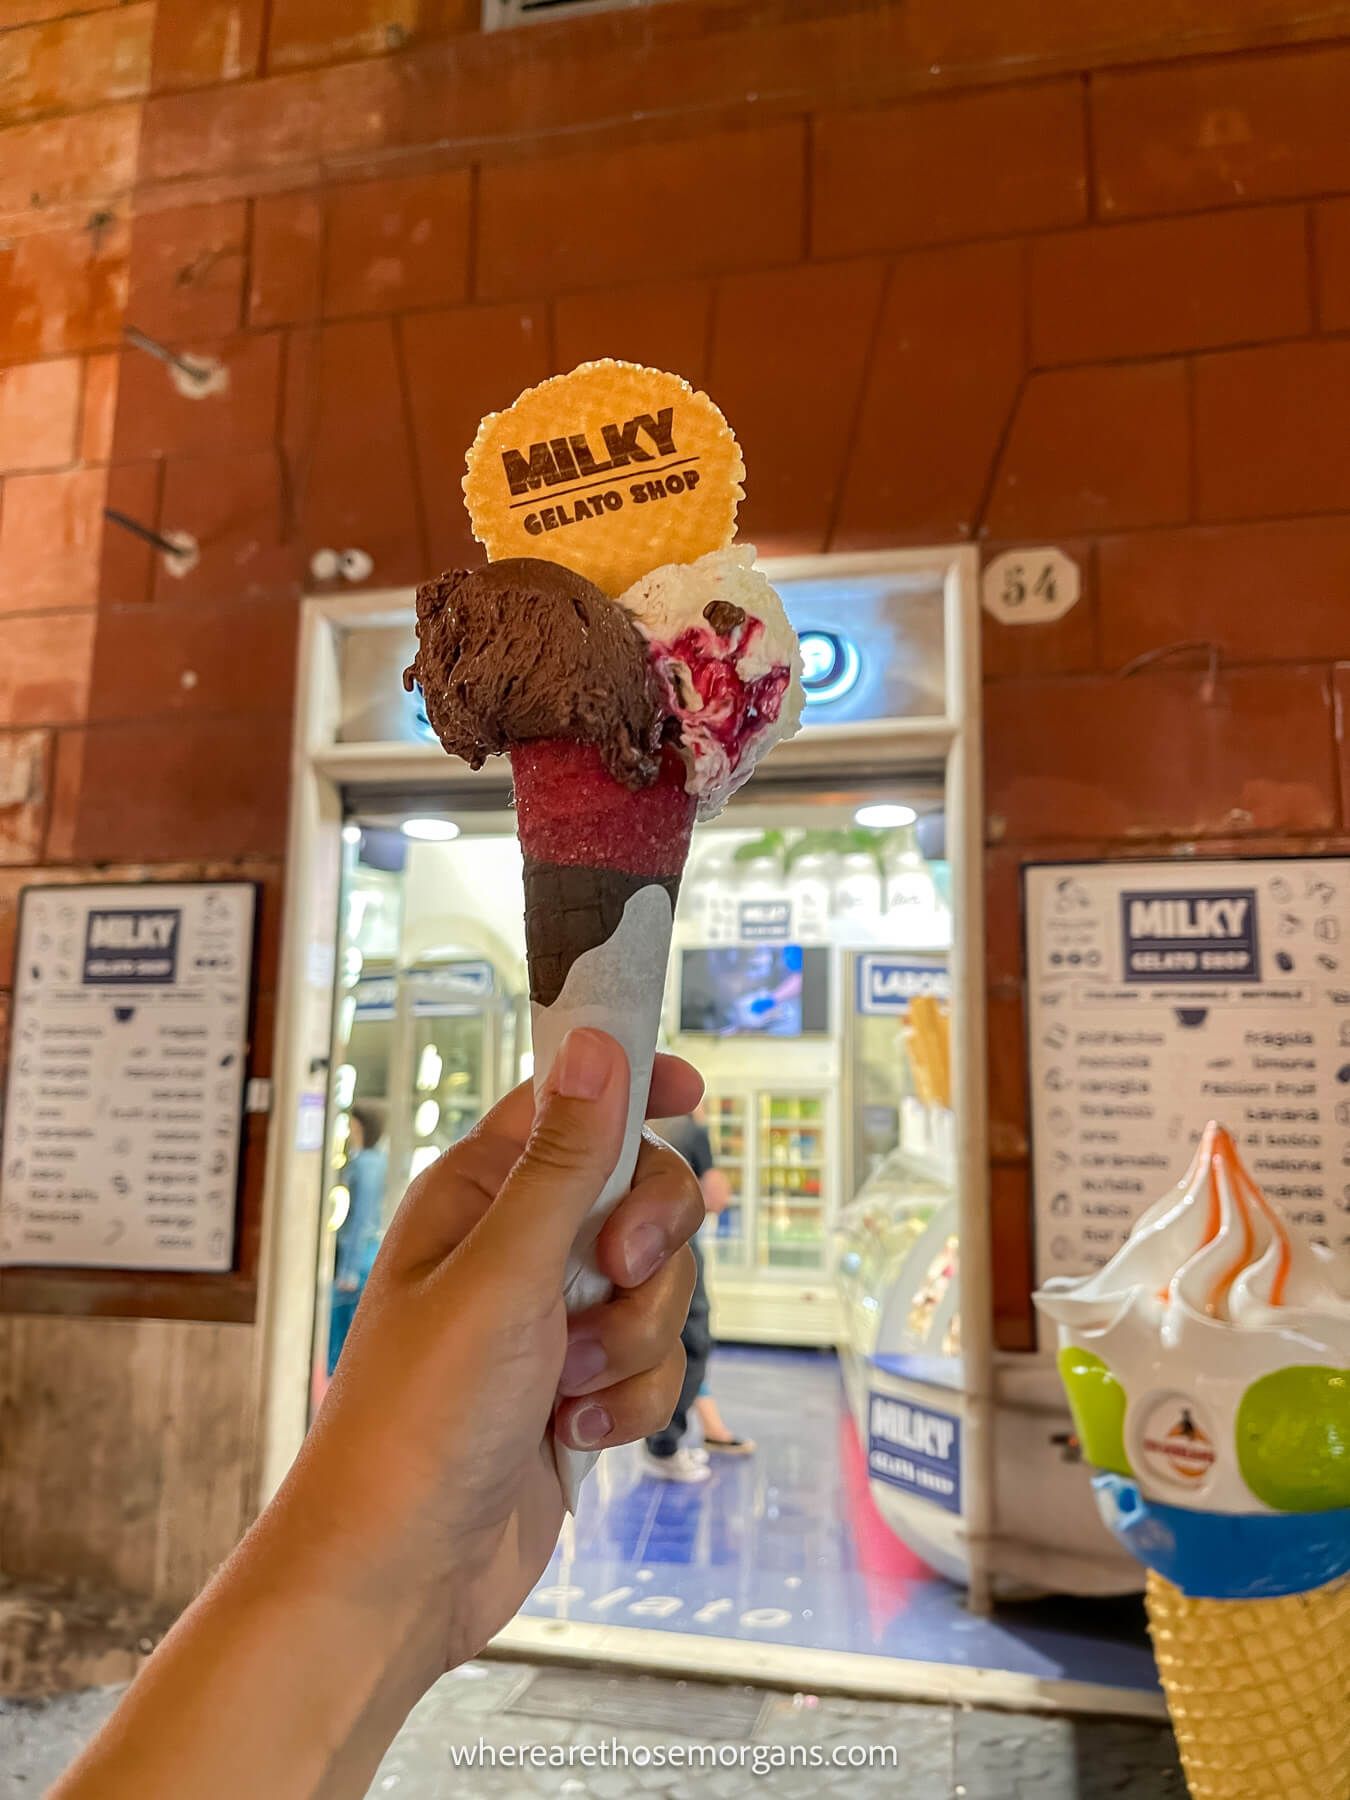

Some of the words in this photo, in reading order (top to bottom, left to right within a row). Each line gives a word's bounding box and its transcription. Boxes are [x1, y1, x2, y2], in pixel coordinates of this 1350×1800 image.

[501, 407, 677, 496] MILKY
[523, 491, 624, 536] GELATO
[629, 469, 700, 504] SHOP
[1002, 565, 1056, 607] 54
[90, 914, 176, 949] MILKY
[1130, 898, 1248, 938] MILKY
[871, 1399, 953, 1459] MILKY
